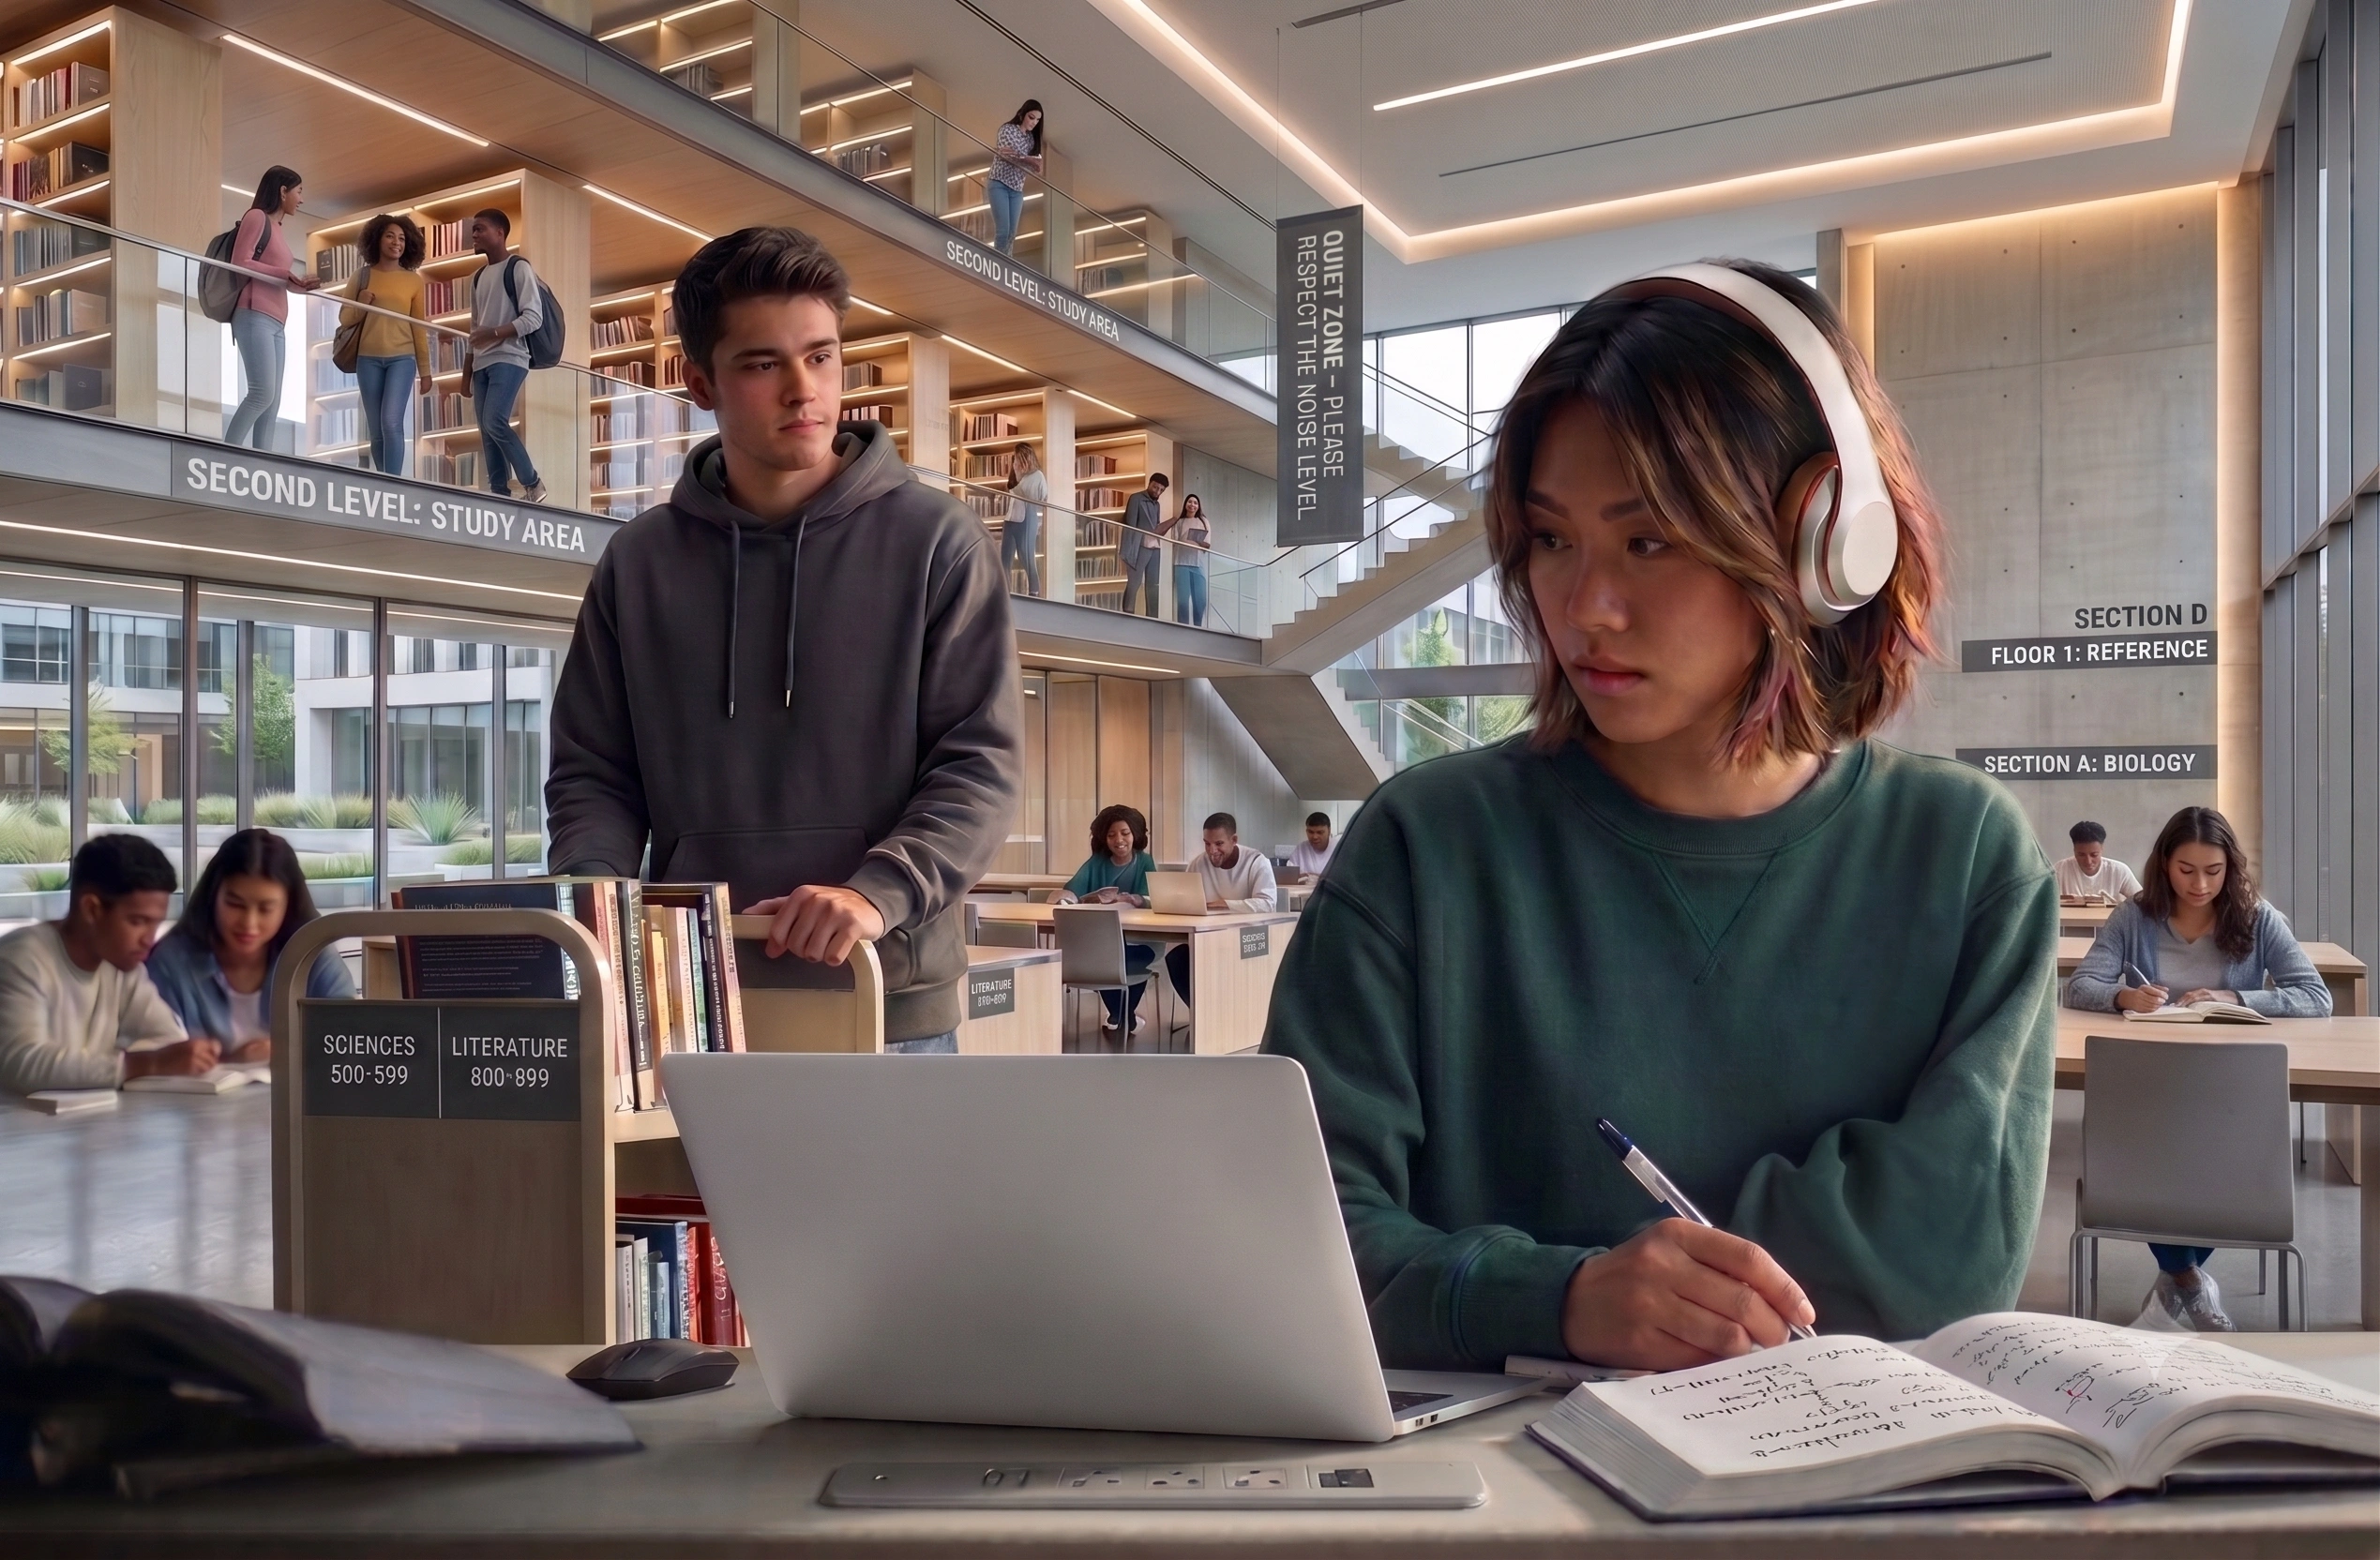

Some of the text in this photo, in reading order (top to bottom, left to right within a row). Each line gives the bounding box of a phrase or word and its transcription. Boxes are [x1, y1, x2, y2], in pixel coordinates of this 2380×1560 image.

[1322, 230, 1344, 298] QUIET
[946, 240, 1120, 341] SECOND LEVEL: STUDY AREA
[1322, 305, 1344, 368] ZONE
[1297, 235, 1317, 521] RESPECT THE NOISE LEVEL
[1323, 396, 1344, 477] PLEASE
[187, 458, 586, 553] SECOND LEVEL: STUDY AREA
[2074, 603, 2207, 629] SECTION D
[1992, 639, 2208, 665] FLOOR 1: REFERENCE
[1984, 753, 2196, 773] SECTION A: BIOLOGY
[324, 1034, 415, 1057] SCIENCES
[452, 1036, 568, 1058] LITERATURE
[331, 1064, 409, 1085] 500-599
